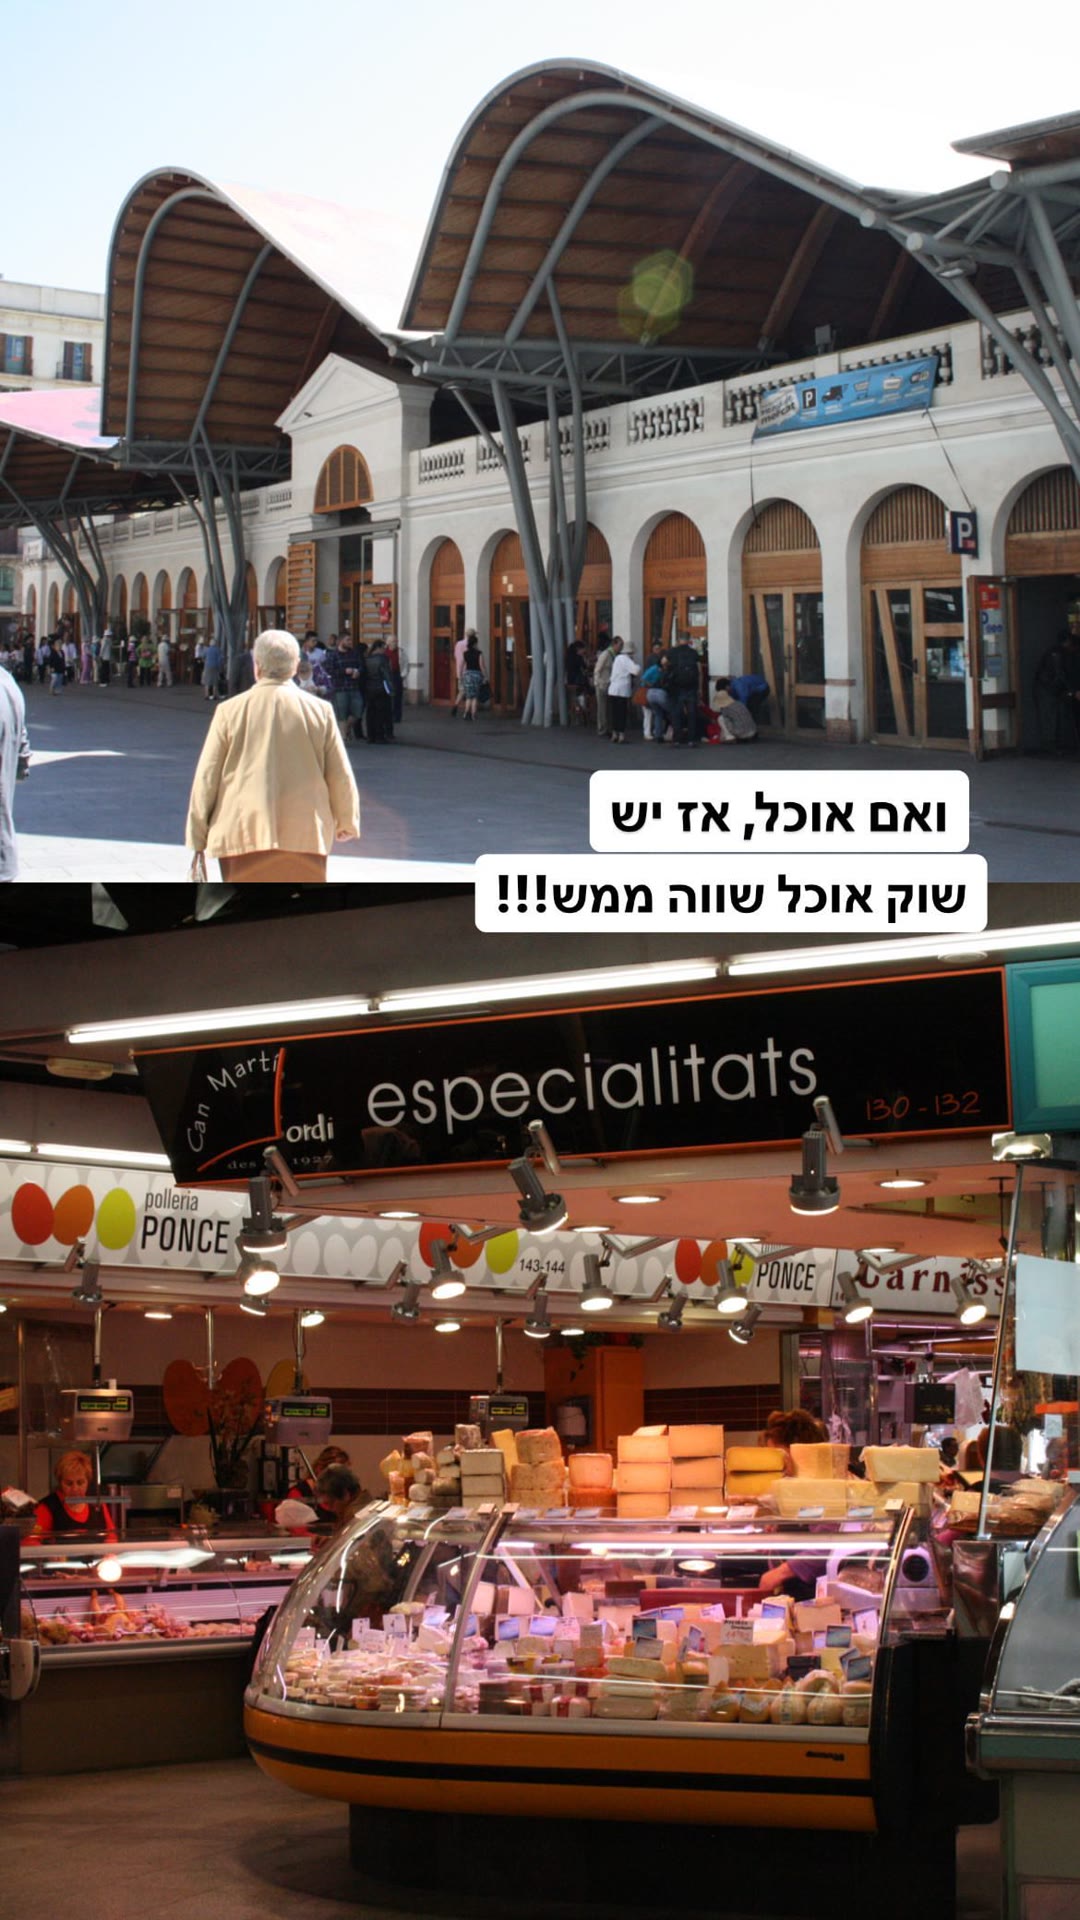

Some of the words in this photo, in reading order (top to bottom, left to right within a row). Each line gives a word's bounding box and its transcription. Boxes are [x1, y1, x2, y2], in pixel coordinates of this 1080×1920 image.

[760, 401, 796, 425] mercat
[957, 517, 973, 549] P
[366, 1036, 818, 1135] especialitats
[865, 1095, 911, 1121] 130
[934, 1090, 981, 1116] 132
[186, 1103, 211, 1152] Can
[293, 1154, 334, 1166] 1927
[144, 1188, 199, 1212] polleria
[140, 1215, 231, 1255] PONCE
[519, 1257, 566, 1274] 143-144
[756, 1260, 817, 1291] PONCE
